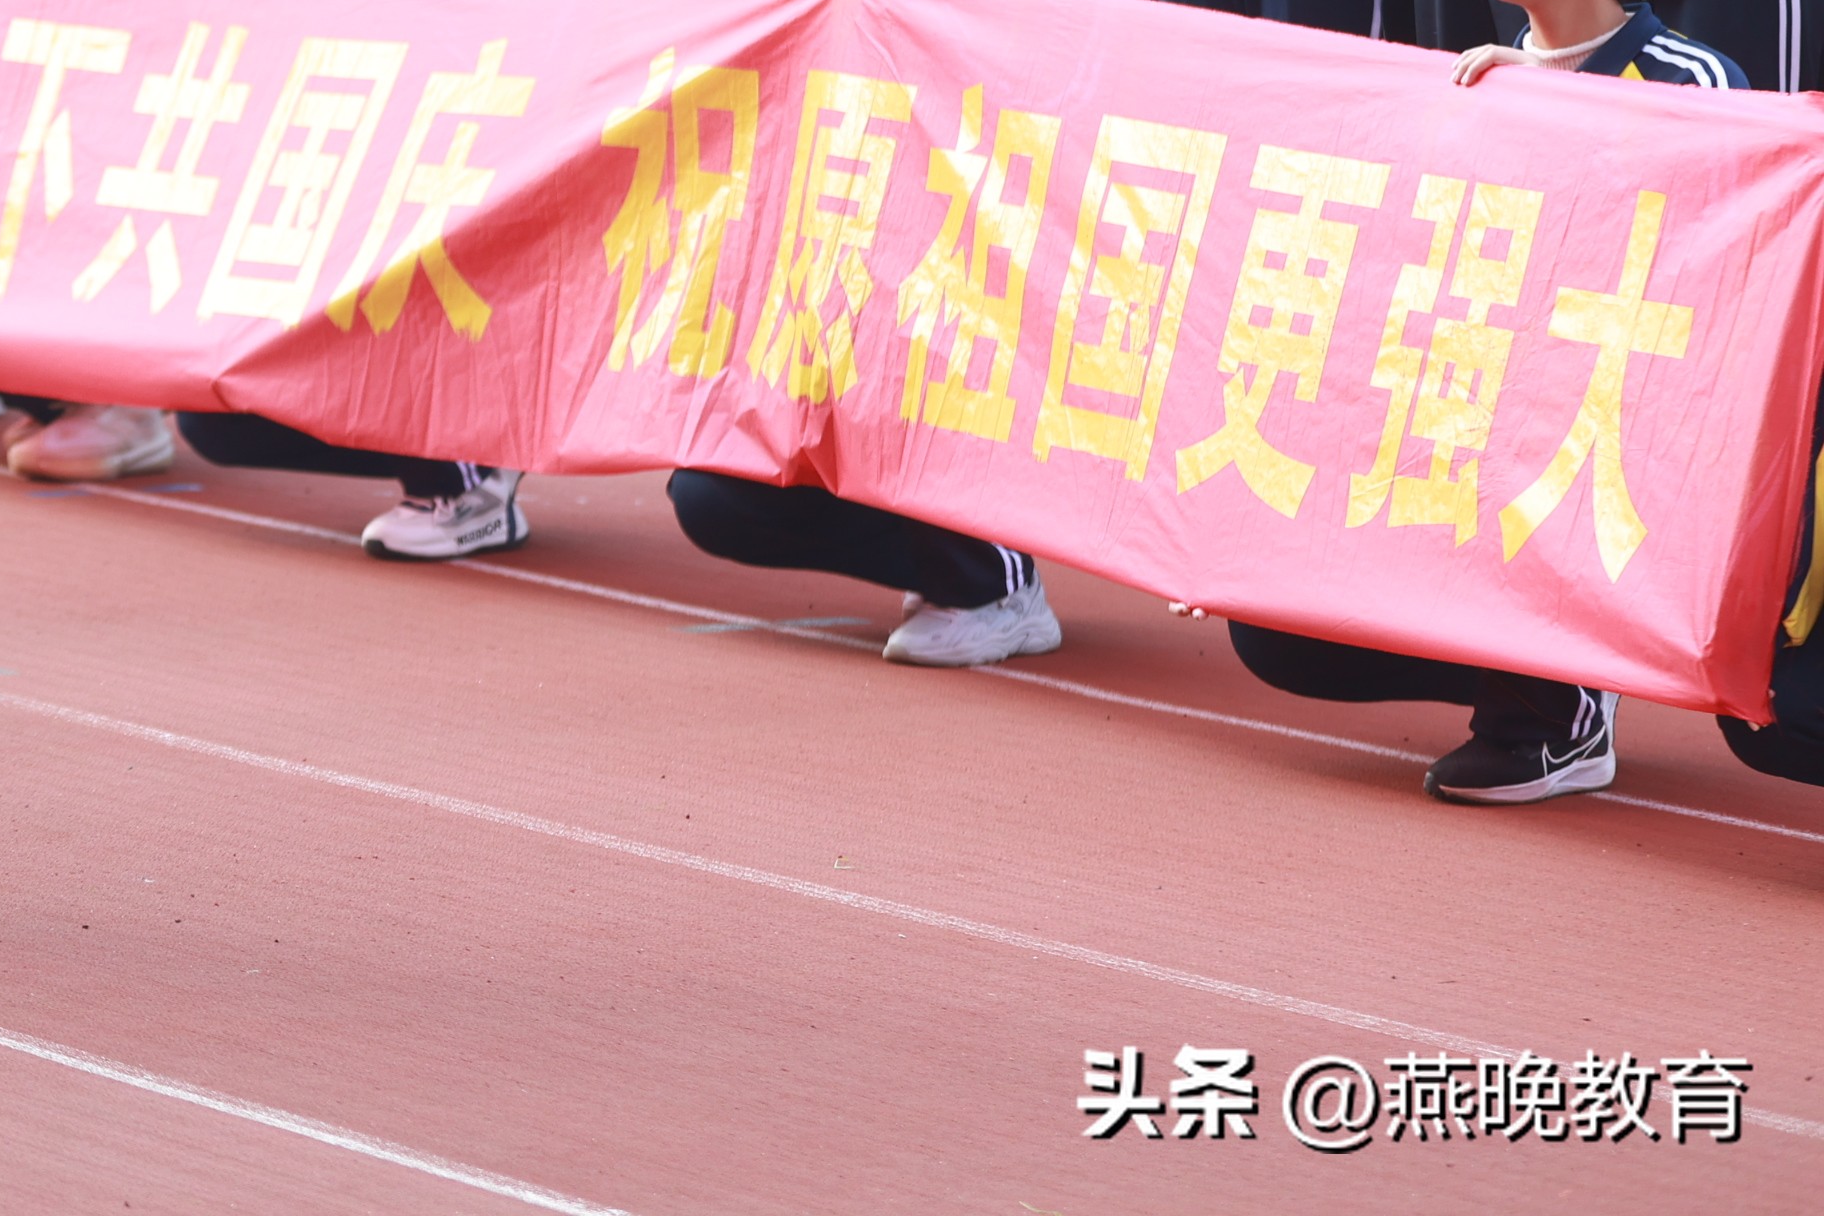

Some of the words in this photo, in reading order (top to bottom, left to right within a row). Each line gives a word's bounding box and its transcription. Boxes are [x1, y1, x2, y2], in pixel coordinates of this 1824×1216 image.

[601, 46, 1695, 584] 祝愿祖国更强大
